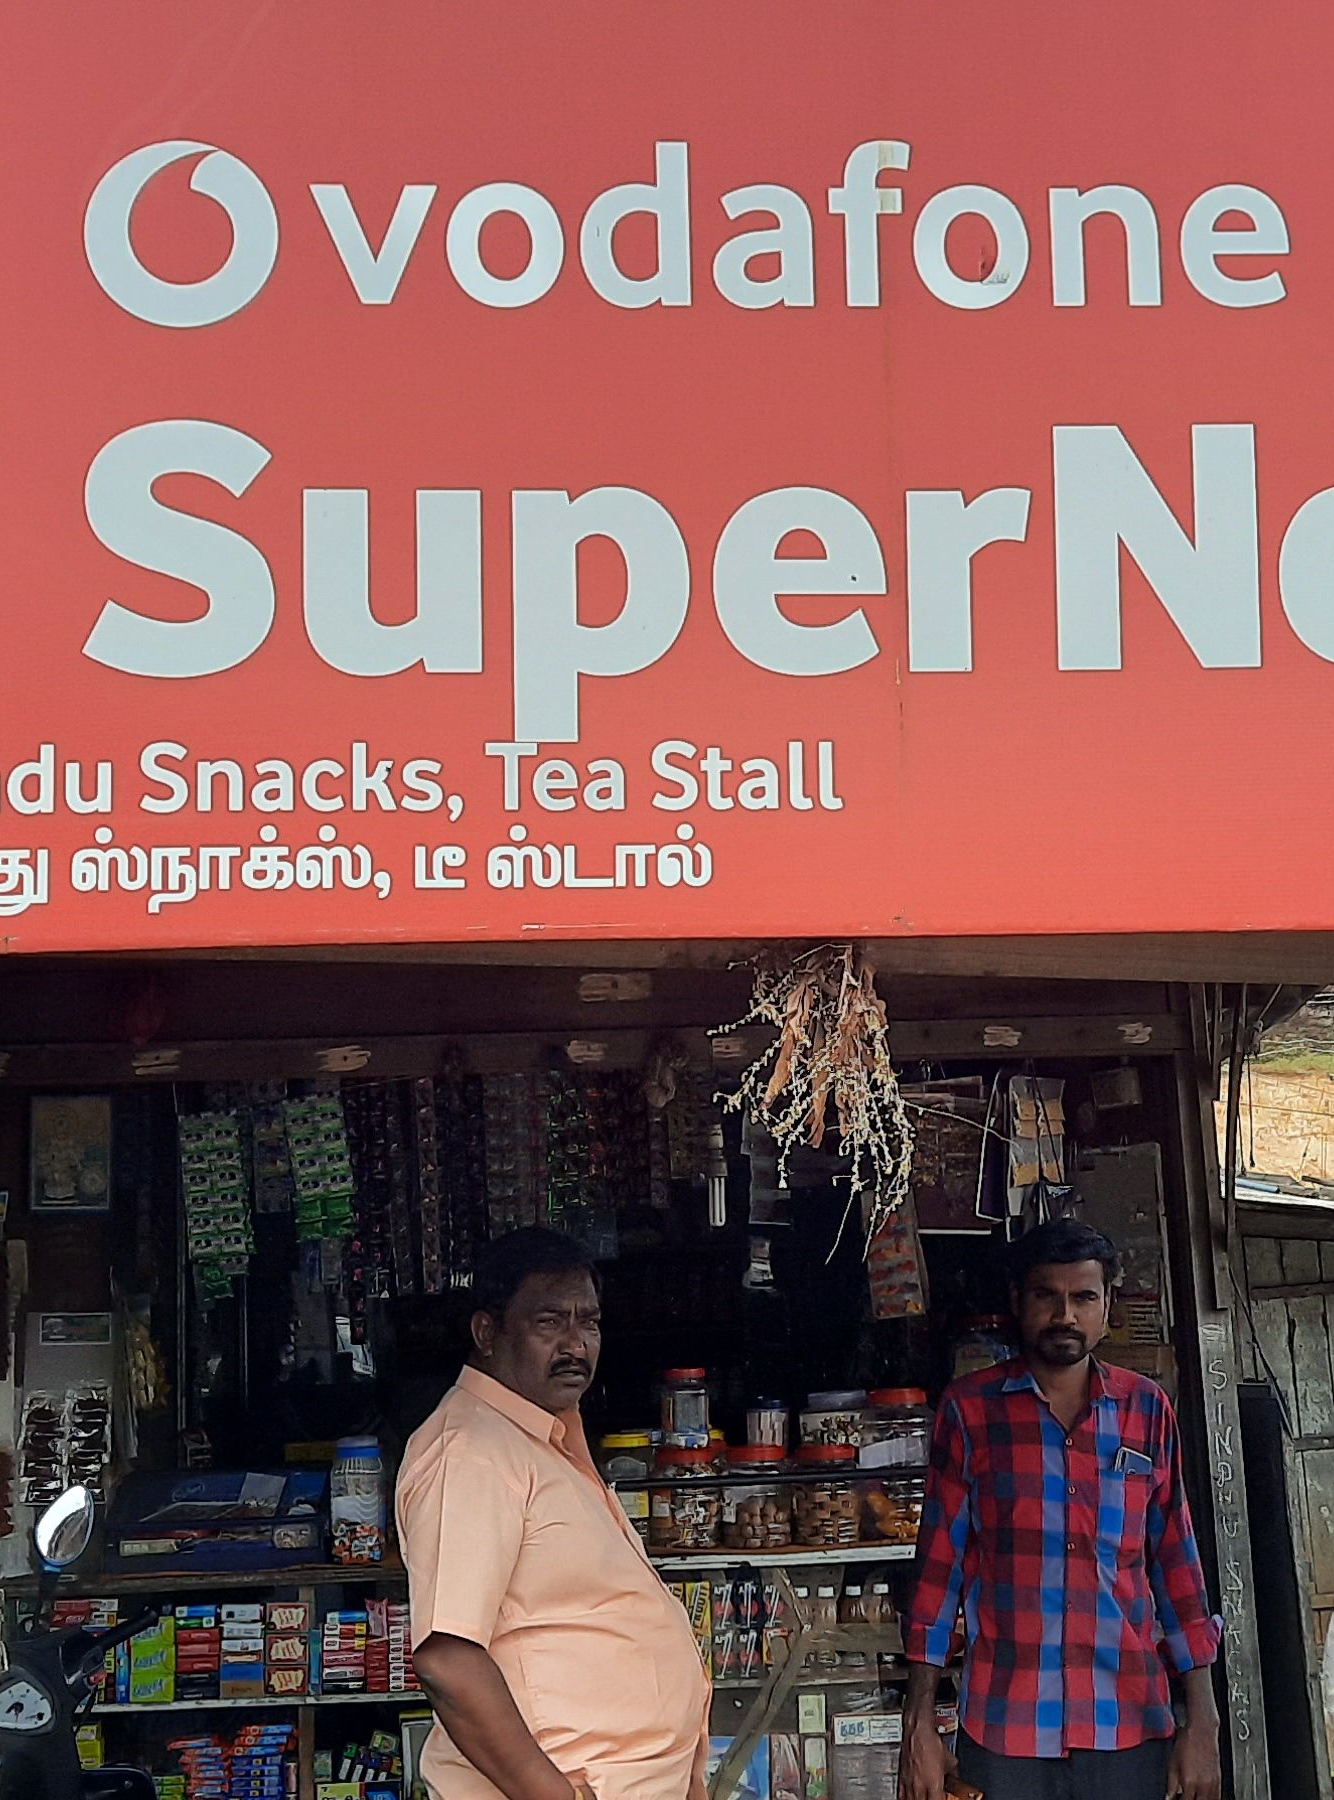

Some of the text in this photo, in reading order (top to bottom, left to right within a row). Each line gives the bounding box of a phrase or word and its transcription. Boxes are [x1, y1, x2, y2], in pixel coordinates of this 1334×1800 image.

[310, 140, 1291, 309] vodafone
[139, 741, 465, 822] Snacks,
[484, 741, 626, 812] Tea
[651, 739, 844, 812] Stall
[71, 824, 393, 914] ஸ்நாக்ஸ்,
[414, 844, 467, 889] டீ
[486, 823, 713, 889] ஸ்டால்
